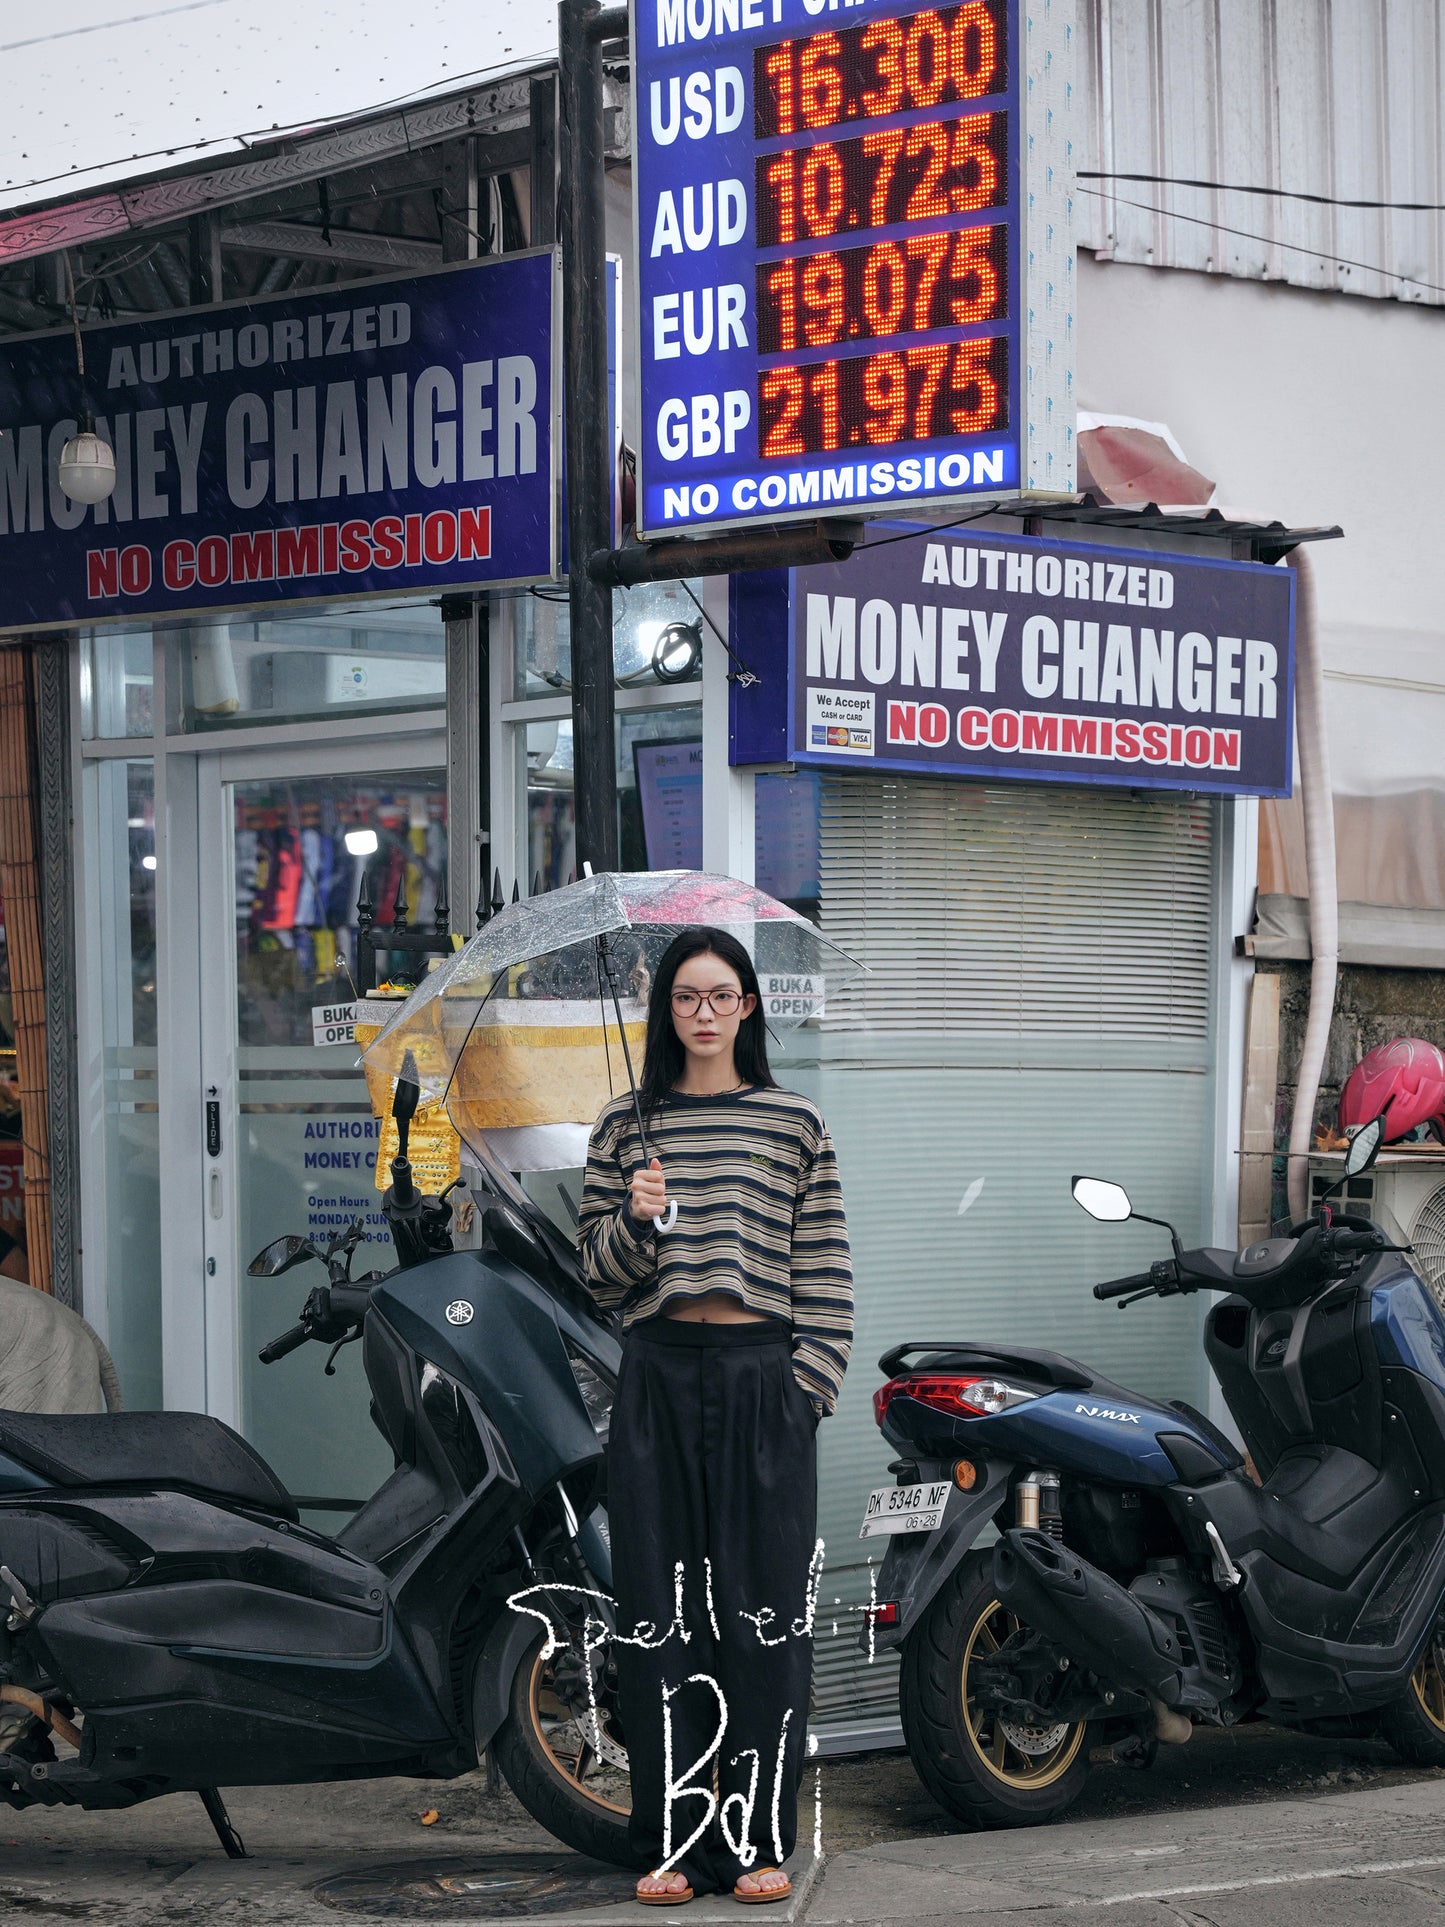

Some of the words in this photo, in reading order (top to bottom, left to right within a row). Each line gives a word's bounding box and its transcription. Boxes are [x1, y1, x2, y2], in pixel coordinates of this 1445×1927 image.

[767, 0, 998, 135] 16.300
[650, 65, 745, 146] USD
[768, 112, 999, 243] 10.725
[650, 178, 748, 258] AUD
[653, 283, 749, 361] EUR
[768, 225, 998, 351] 19.075
[107, 302, 412, 390] AUTHORIZED
[225, 354, 538, 510] CHANGER
[656, 389, 751, 462] GBP
[762, 337, 998, 457] 21.975
[663, 484, 719, 519] NO
[731, 449, 1004, 510] COMMISSION
[86, 544, 152, 600] NO
[162, 505, 493, 592] COMMISSION
[921, 543, 1174, 610] AUTHORIZED
[806, 593, 1008, 693] MONEY
[1021, 614, 1279, 719] CHANGER
[817, 694, 832, 706] We
[835, 696, 871, 710] Accept
[821, 711, 838, 720] CASH
[886, 700, 950, 749] NO
[956, 705, 1242, 772] COMMISSION
[853, 734, 869, 743] VISA
[323, 1006, 357, 1024] BUK
[769, 978, 813, 994] BUKA
[770, 999, 813, 1015] OPEN
[304, 1121, 382, 1139] AUTHORI
[304, 1151, 361, 1168] MONEY
[308, 1196, 337, 1209] Open
[339, 1195, 370, 1207] Hours
[308, 1213, 356, 1225] MONDAY
[1075, 1404, 1141, 1424] NMAX
[868, 1492, 885, 1514] DK
[889, 1488, 922, 1510] 5346
[927, 1485, 947, 1506] NF
